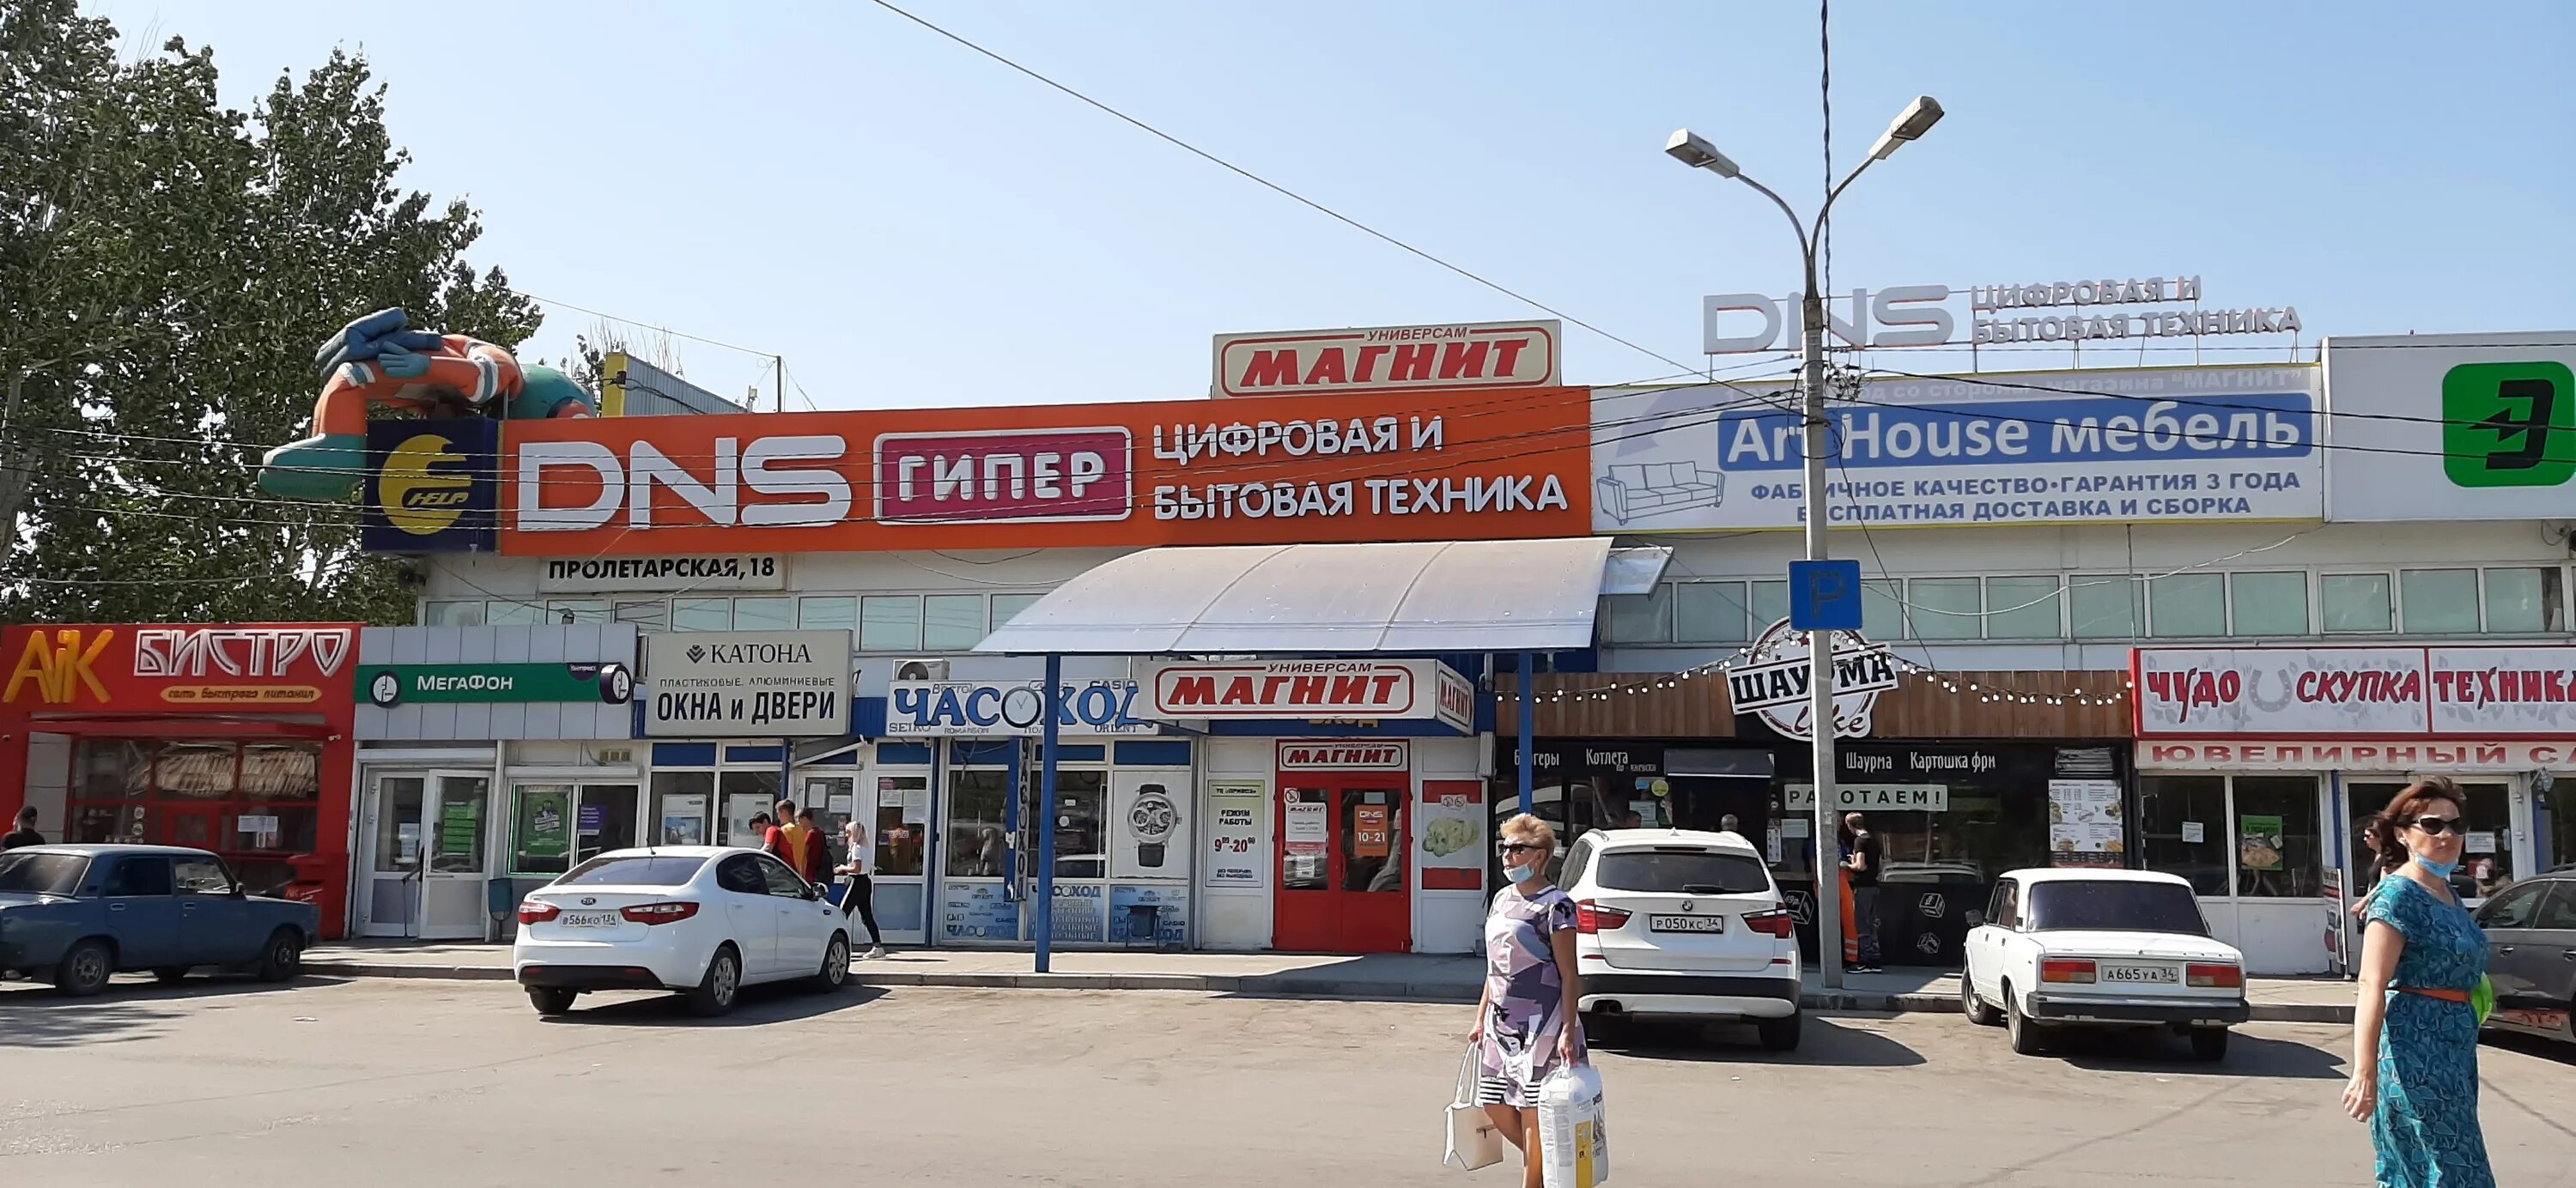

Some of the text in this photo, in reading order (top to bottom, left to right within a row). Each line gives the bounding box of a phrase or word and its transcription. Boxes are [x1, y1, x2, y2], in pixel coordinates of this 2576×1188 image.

[1971, 276, 2202, 313] ЦИФРОВАЯ И
[1366, 327, 1467, 342] УНИВЕРСАМ
[1704, 285, 1953, 355] DNS
[1971, 306, 2302, 344] БЫТОВАЯ ТЕХНИКА
[1240, 338, 1528, 387] МАГНИТ
[1154, 415, 1443, 466] ЦИФРОВАЯ И
[1841, 413, 2030, 459] House
[2051, 402, 2300, 453] мебель
[518, 435, 852, 531] DNS
[899, 452, 1105, 501] ГИПЕР
[1751, 481, 1905, 500] ФАБИЧНОЕ
[2207, 473, 2220, 489] 3
[2229, 472, 2300, 492] ГОДА
[407, 493, 469, 506] HELP
[1154, 474, 1569, 520] БЫТОВАЯ ТЕХНИКА
[1797, 497, 2251, 522] БСПЛАТНАЯ ДОСТАВКА И СБОРКА
[134, 629, 352, 677] БИСТРО
[710, 644, 812, 664] КАТОНА
[1267, 663, 1373, 674] УНИВЕРСАМ
[749, 676, 835, 687] АЛЮМИНИЕВЫЕ
[1167, 676, 1400, 705] МАГНИТ
[1730, 652, 1895, 705] ШАУМА
[657, 692, 722, 721] ОКНА
[751, 691, 835, 725] ДВЕРИ
[2147, 667, 2240, 724] ЧУДО
[2297, 670, 2421, 704] СКУПКА
[1794, 704, 1866, 735] lke
[1288, 749, 1397, 763] МАГНИТ
[1514, 749, 1996, 773] Бгеры Котлета Шаурма Картошка фри
[2152, 742, 2507, 764] ЮВЕЛИРНЫЙ
[1789, 790, 1941, 805] РАОТАЕМ!
[1032, 885, 1102, 898] СОХОД
